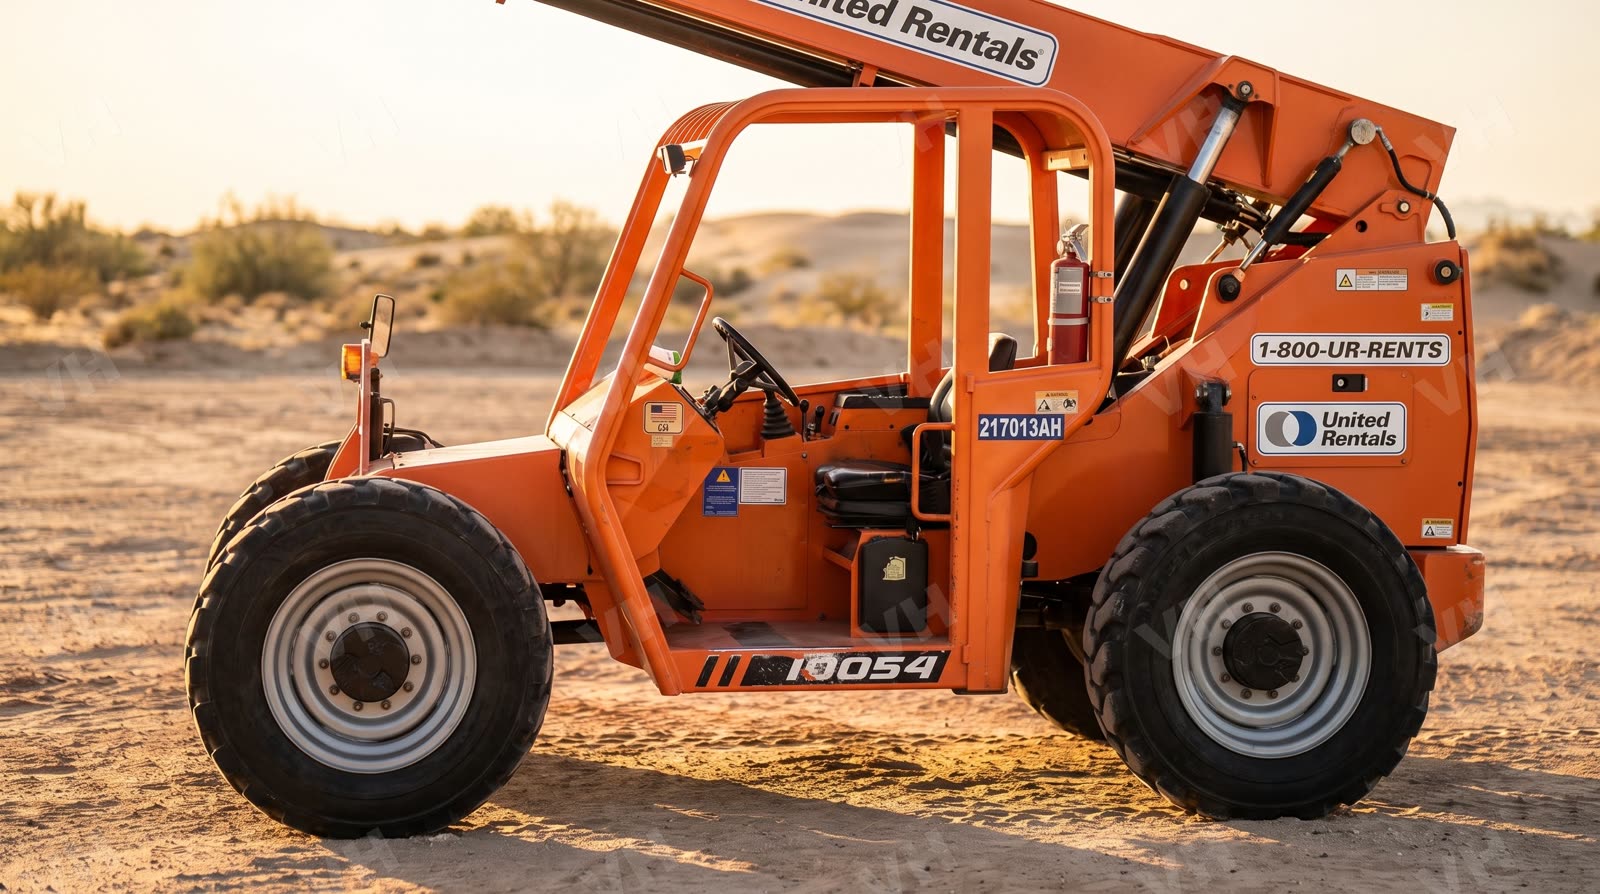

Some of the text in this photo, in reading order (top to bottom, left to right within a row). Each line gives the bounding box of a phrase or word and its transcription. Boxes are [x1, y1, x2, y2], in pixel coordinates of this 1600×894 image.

[1259, 341, 1443, 359] 1-800-UR-RENTS
[979, 417, 1062, 438] 217013AH
[1322, 411, 1391, 428] United
[1321, 430, 1397, 447] Rentals
[785, 655, 938, 682] 10054
